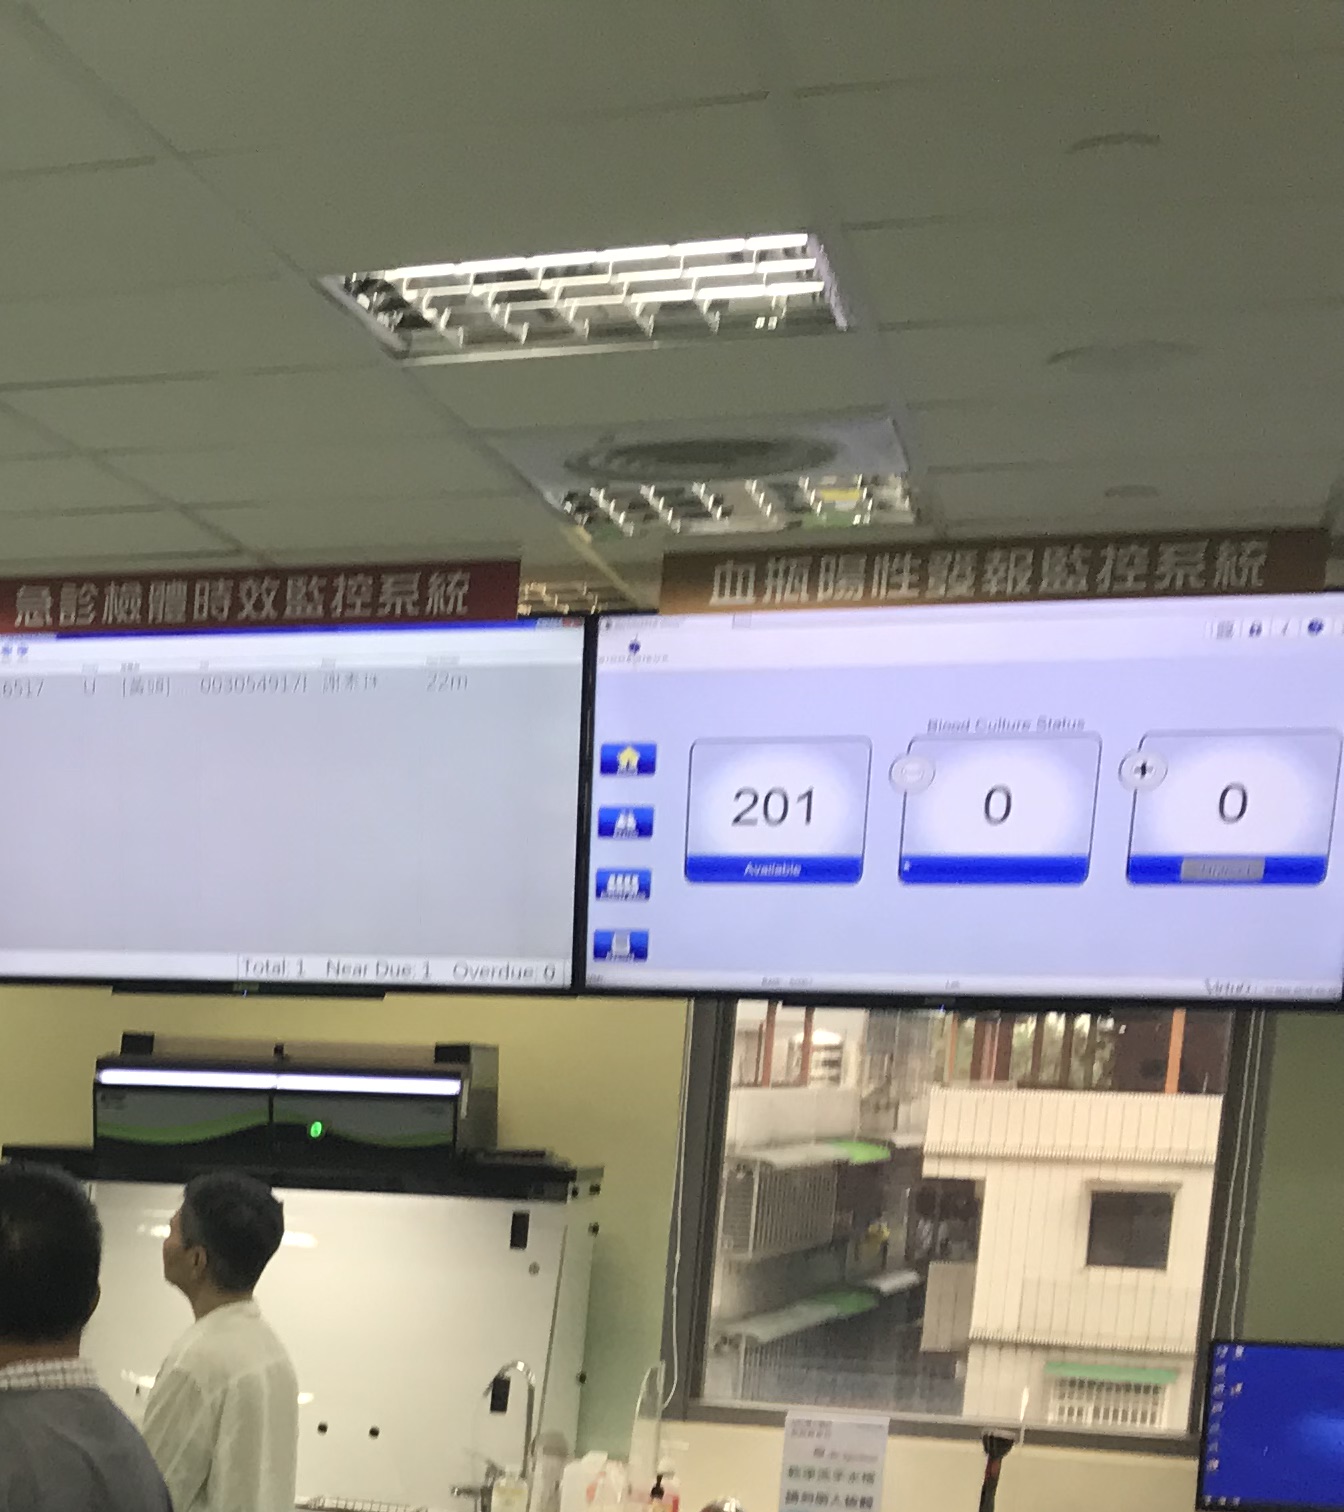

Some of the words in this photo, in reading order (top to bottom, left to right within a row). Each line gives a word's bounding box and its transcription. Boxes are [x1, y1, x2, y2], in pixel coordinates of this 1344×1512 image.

[14, 571, 471, 628] 急診檢體時效監控系統
[731, 785, 815, 827] 201
[983, 784, 1013, 827] 0
[1218, 782, 1248, 825] 0
[744, 861, 802, 877] Available
[326, 958, 368, 977] Near
